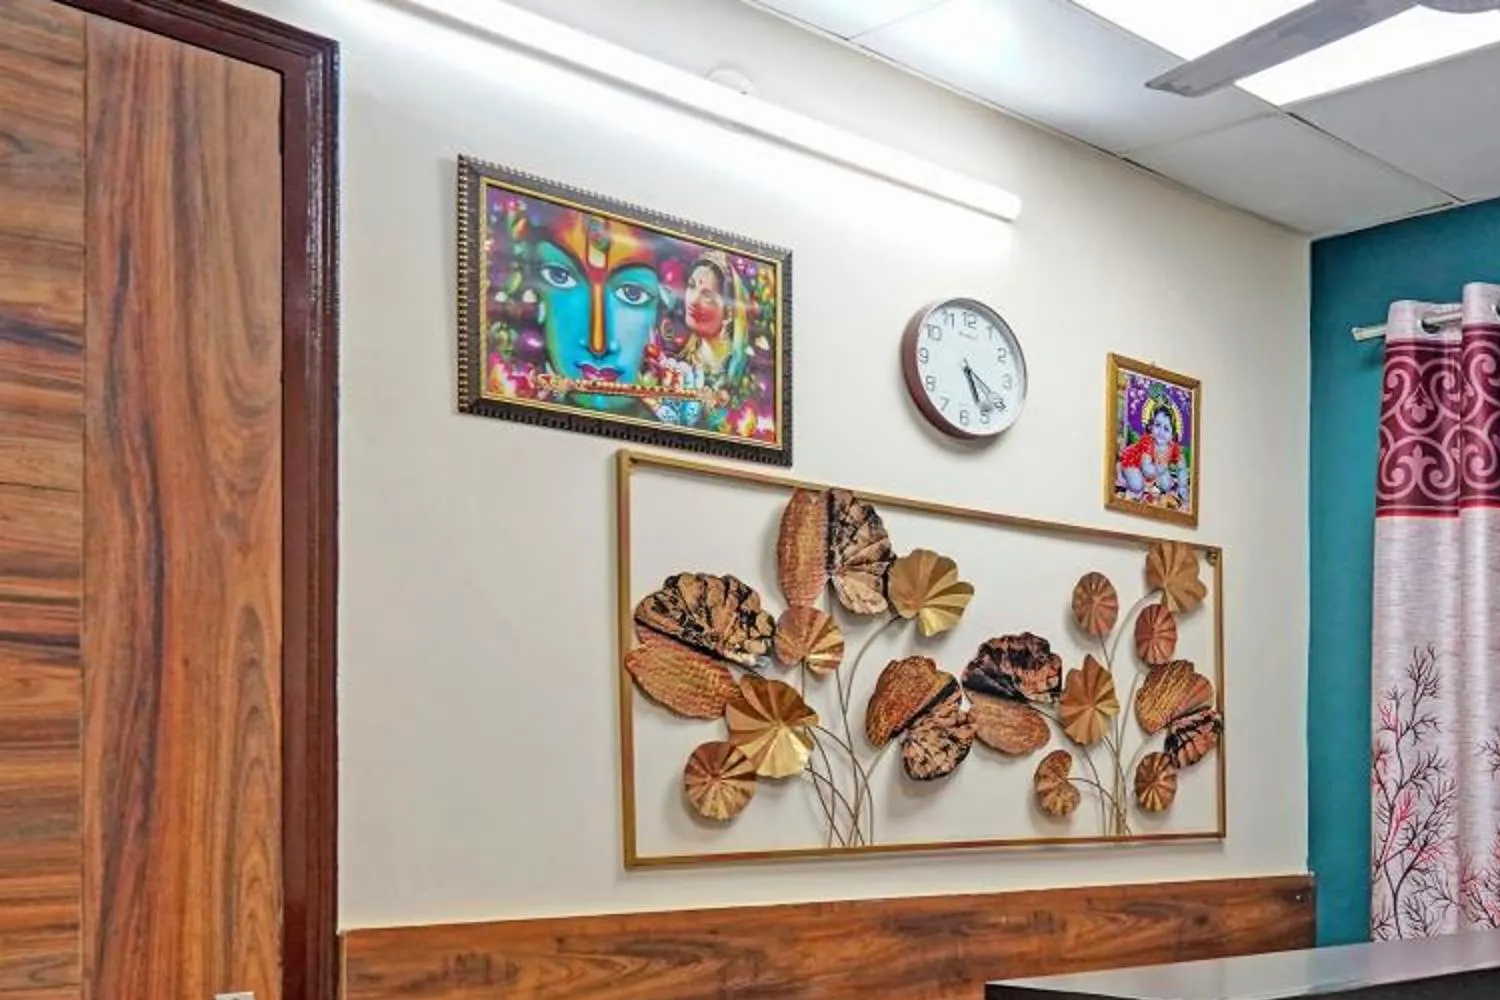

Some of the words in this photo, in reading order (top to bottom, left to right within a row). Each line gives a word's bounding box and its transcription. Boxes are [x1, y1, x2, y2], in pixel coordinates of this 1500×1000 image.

[962, 311, 977, 330] 12
[927, 323, 943, 342] 10
[997, 347, 1007, 363] 2
[959, 409, 970, 426] 6
